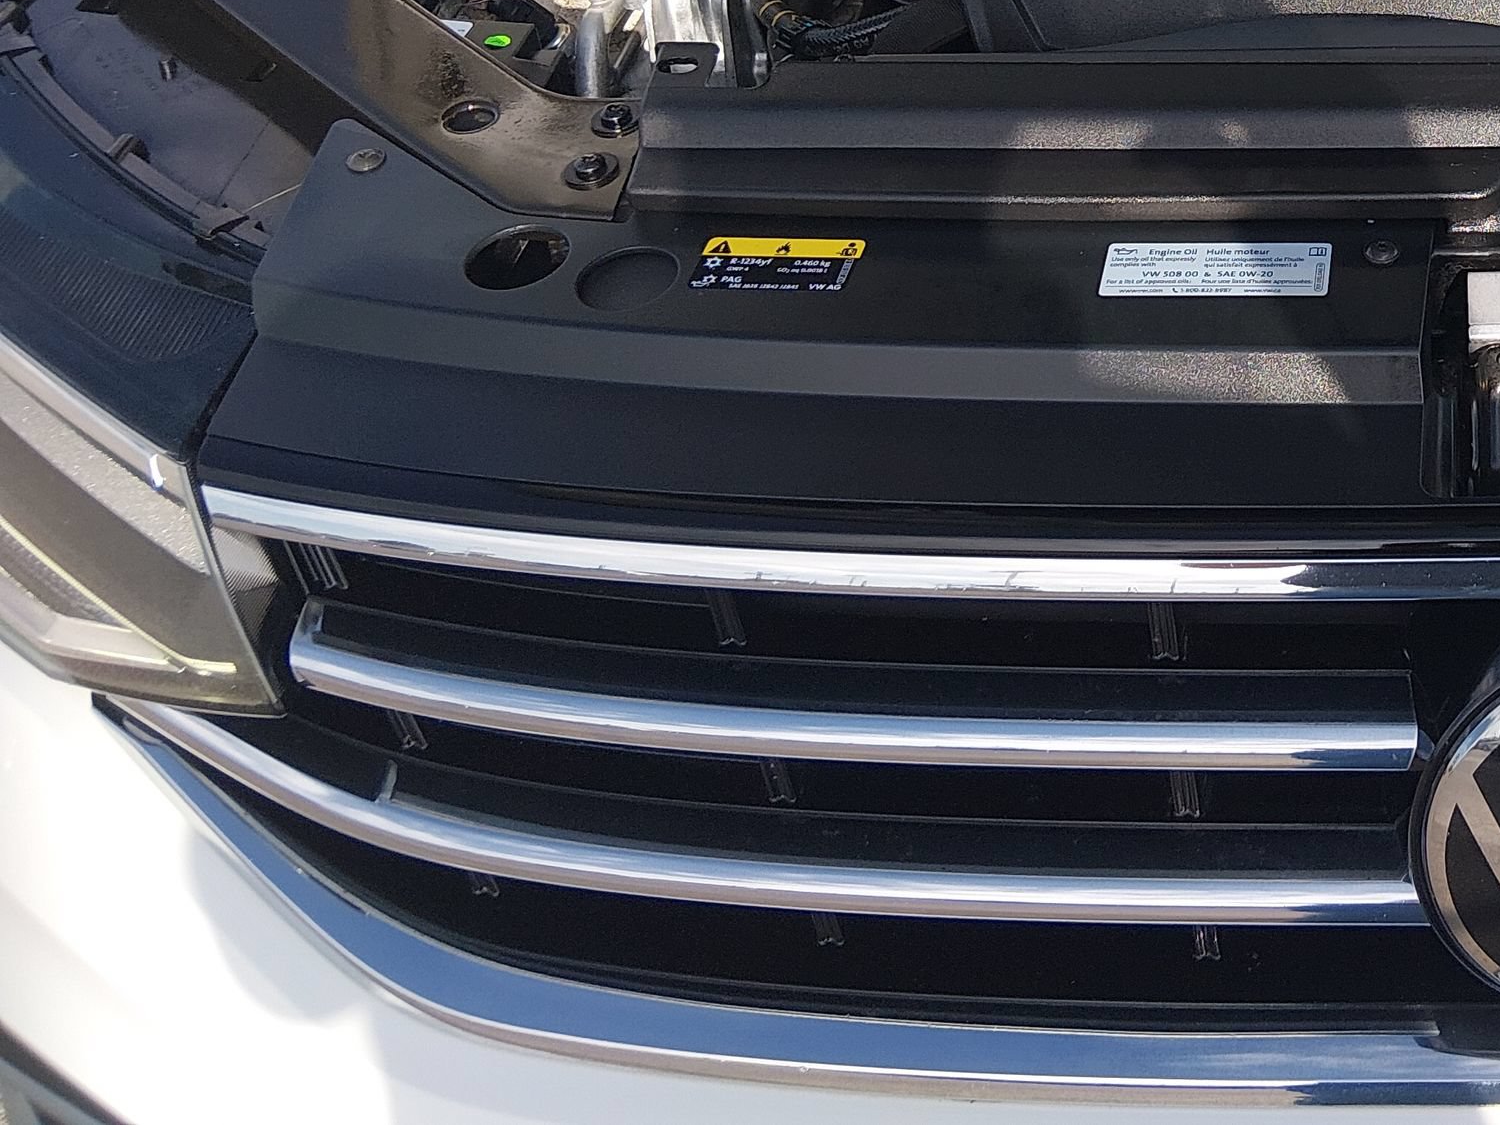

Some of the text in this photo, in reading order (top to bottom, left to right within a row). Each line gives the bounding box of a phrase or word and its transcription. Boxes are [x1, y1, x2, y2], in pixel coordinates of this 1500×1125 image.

[1148, 248, 1198, 257] Engine Oil
[1206, 248, 1271, 256] Huile moteur
[729, 257, 831, 268] R-1234yf 0.460 kg
[720, 275, 742, 283] PAG
[808, 283, 827, 291] VW
